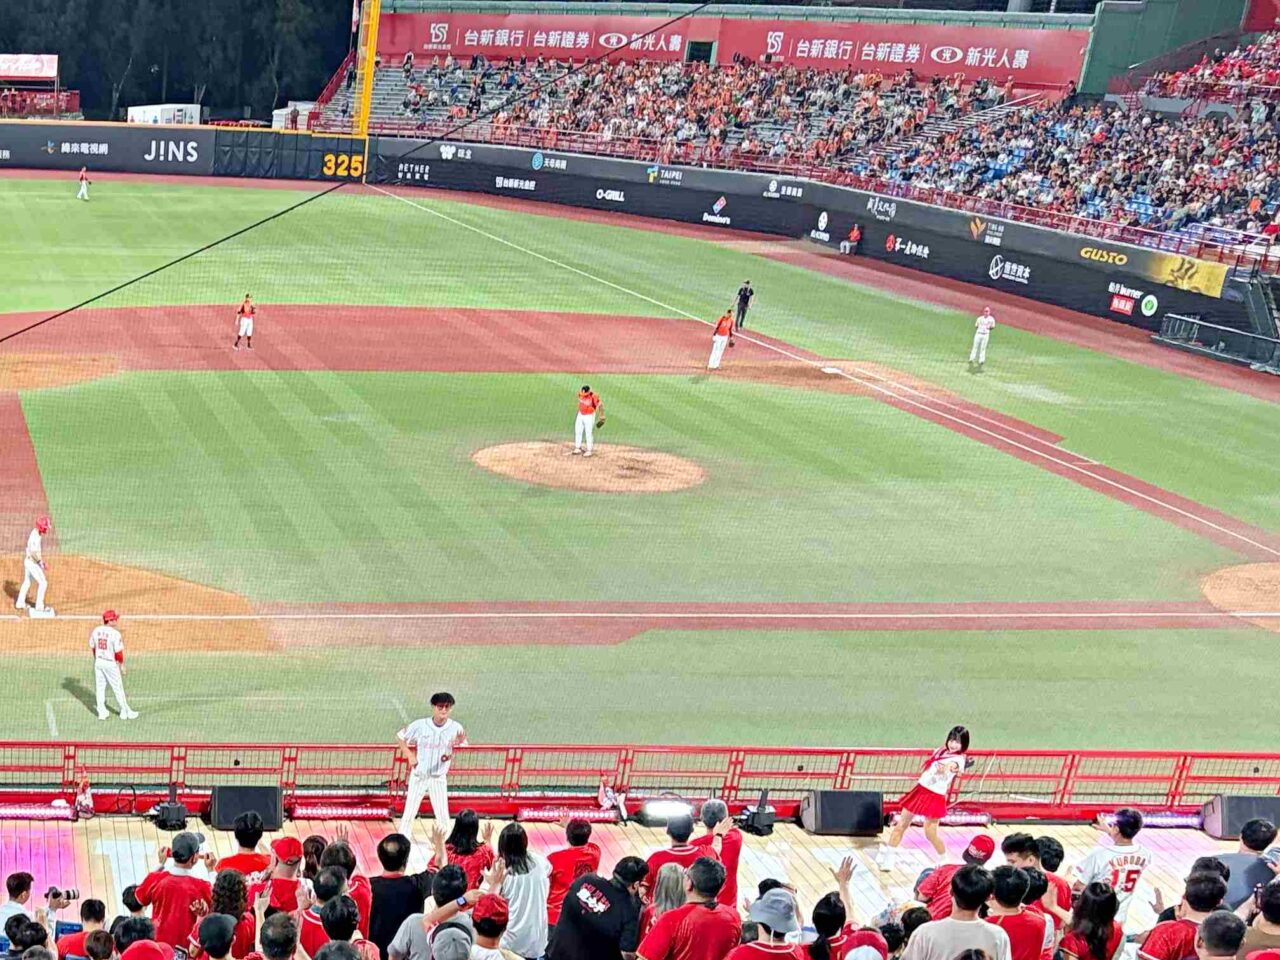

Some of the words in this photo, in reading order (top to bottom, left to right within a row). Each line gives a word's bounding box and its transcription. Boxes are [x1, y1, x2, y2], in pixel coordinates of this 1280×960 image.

[465, 29, 526, 47] 台新銀行
[533, 29, 590, 48] 台新證券
[630, 31, 682, 53] 新光人壽
[796, 37, 853, 60] 台新銀行
[861, 41, 922, 65] 台新證券
[965, 46, 1030, 70] 新光人壽
[322, 153, 363, 178] 325
[660, 169, 683, 181] TAIPEI
[1080, 247, 1128, 266] GUSTO
[1110, 868, 1141, 893] 15
